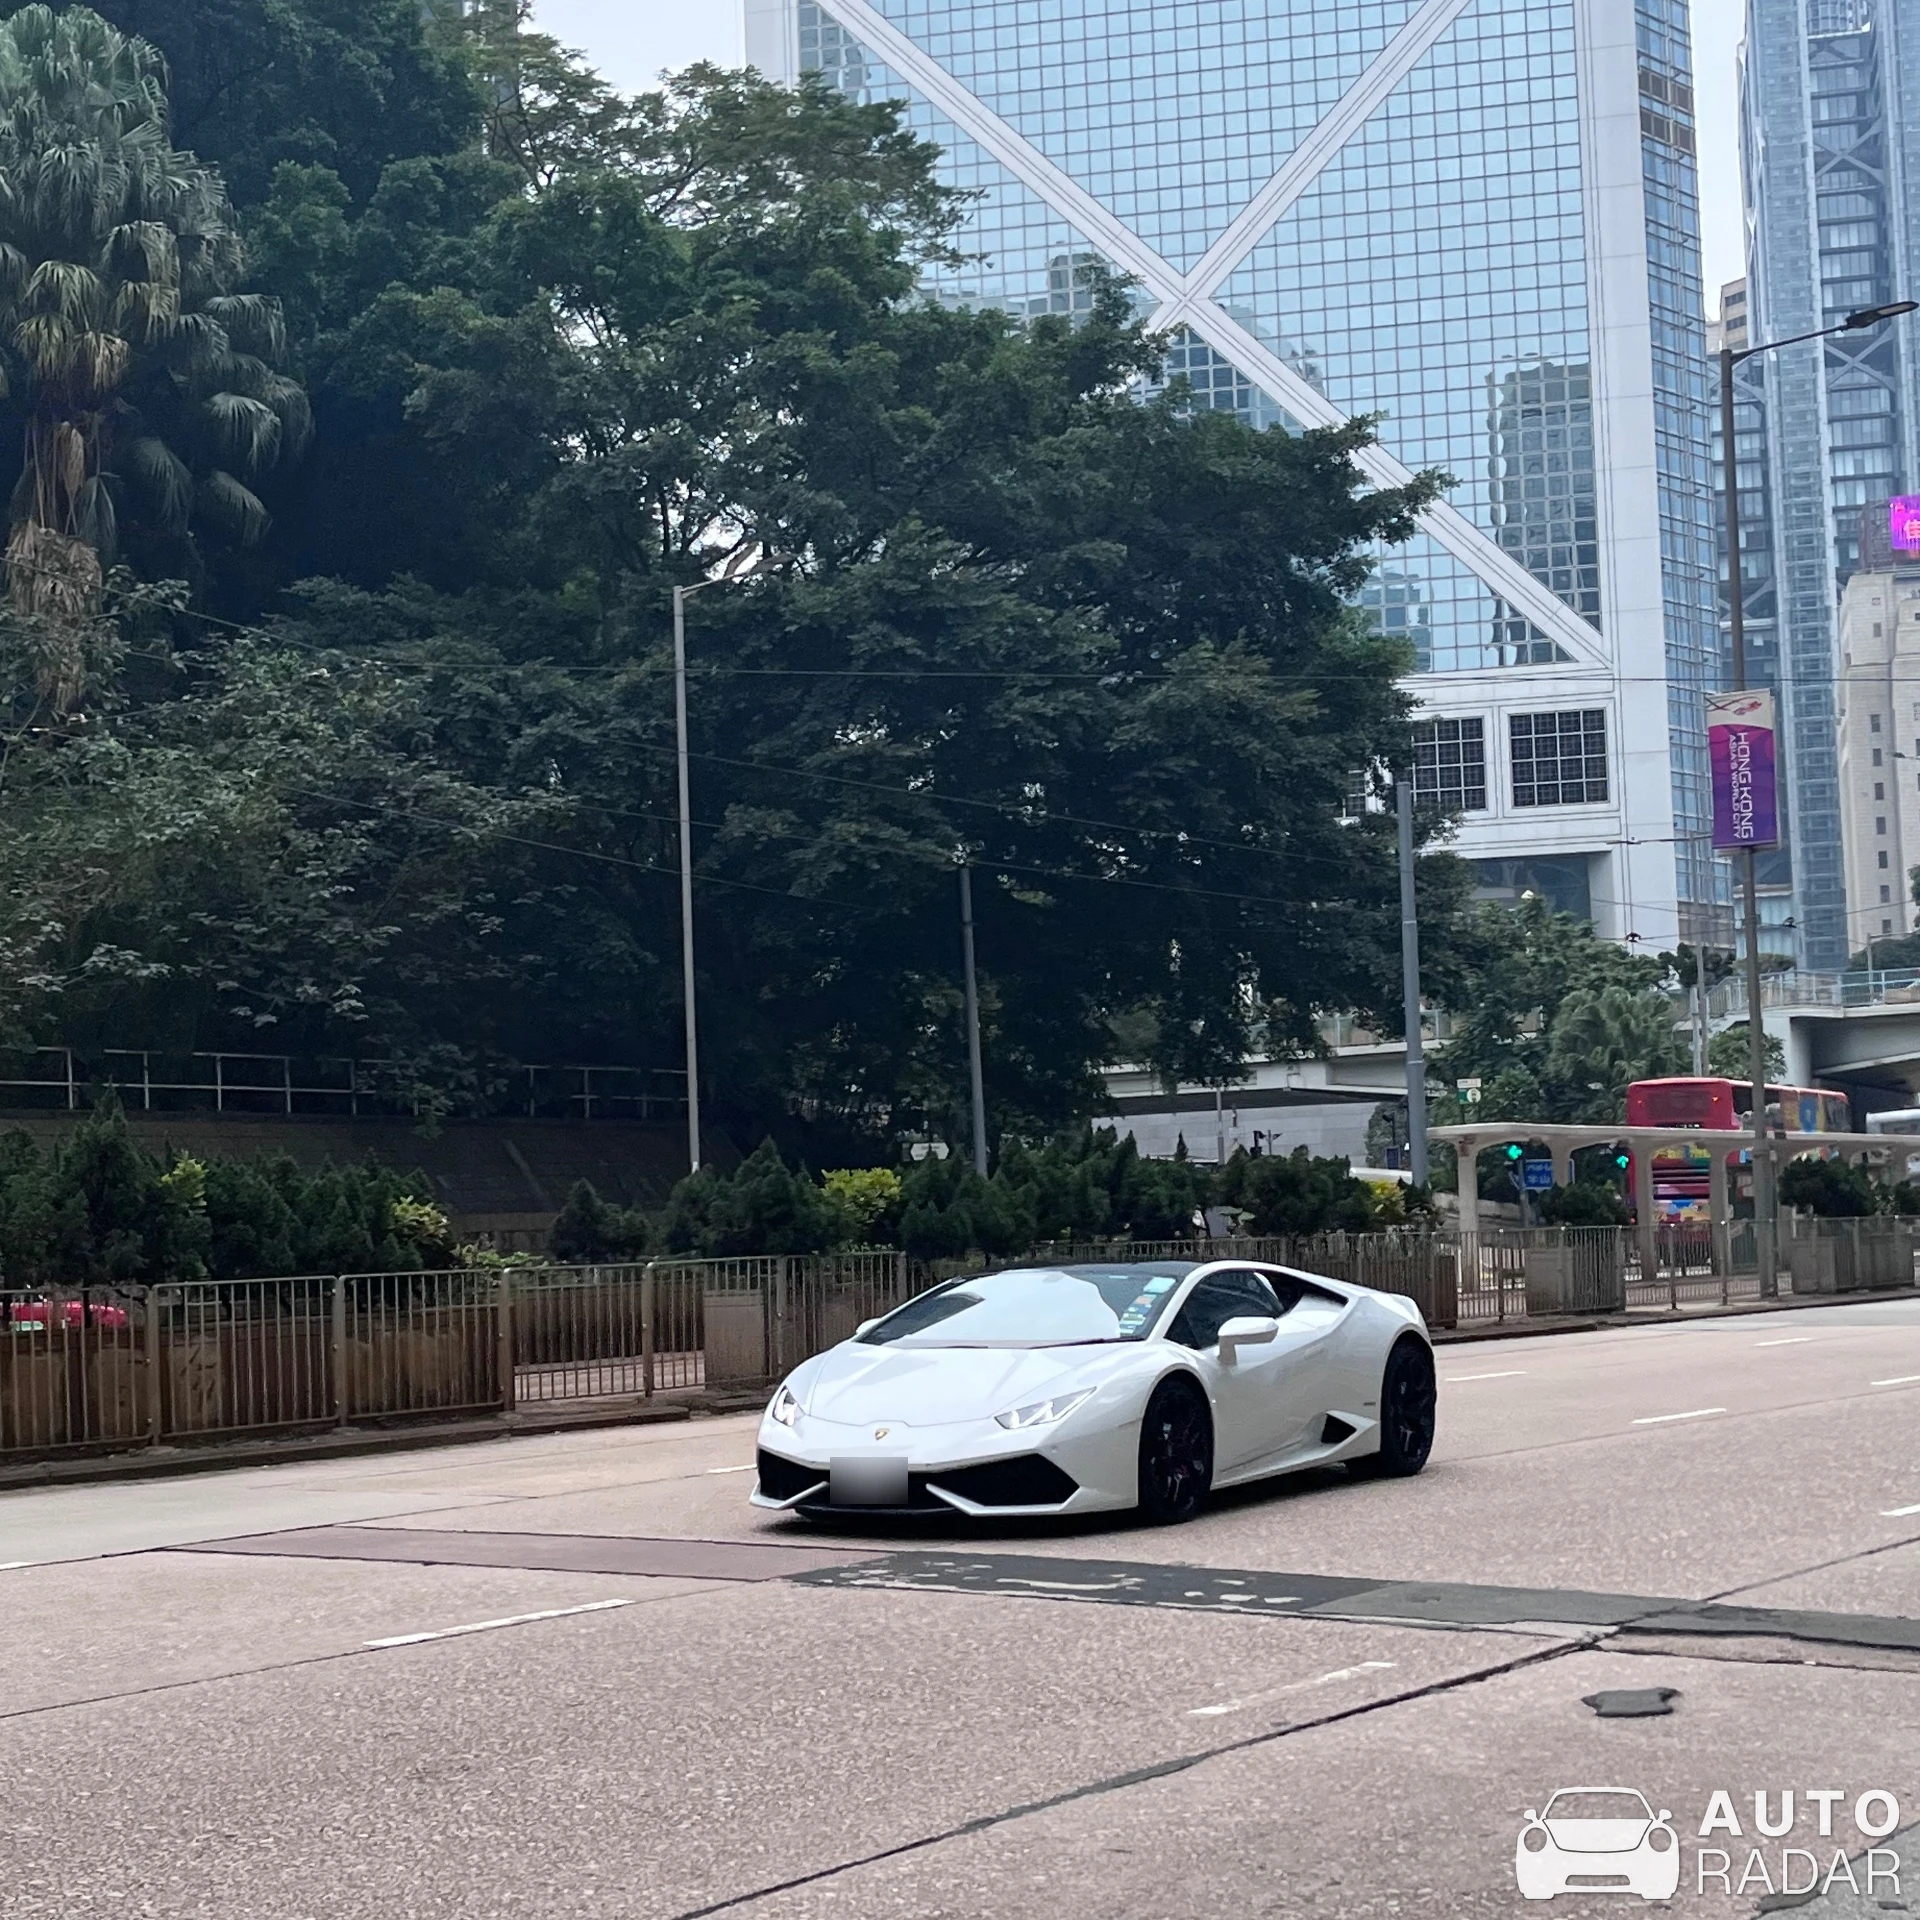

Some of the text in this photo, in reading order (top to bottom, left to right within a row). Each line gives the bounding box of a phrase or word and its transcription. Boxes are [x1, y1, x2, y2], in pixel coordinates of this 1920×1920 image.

[1729, 734, 1741, 838] ASIA'S WORLD CITY
[1737, 732, 1753, 838] HONG KONG
